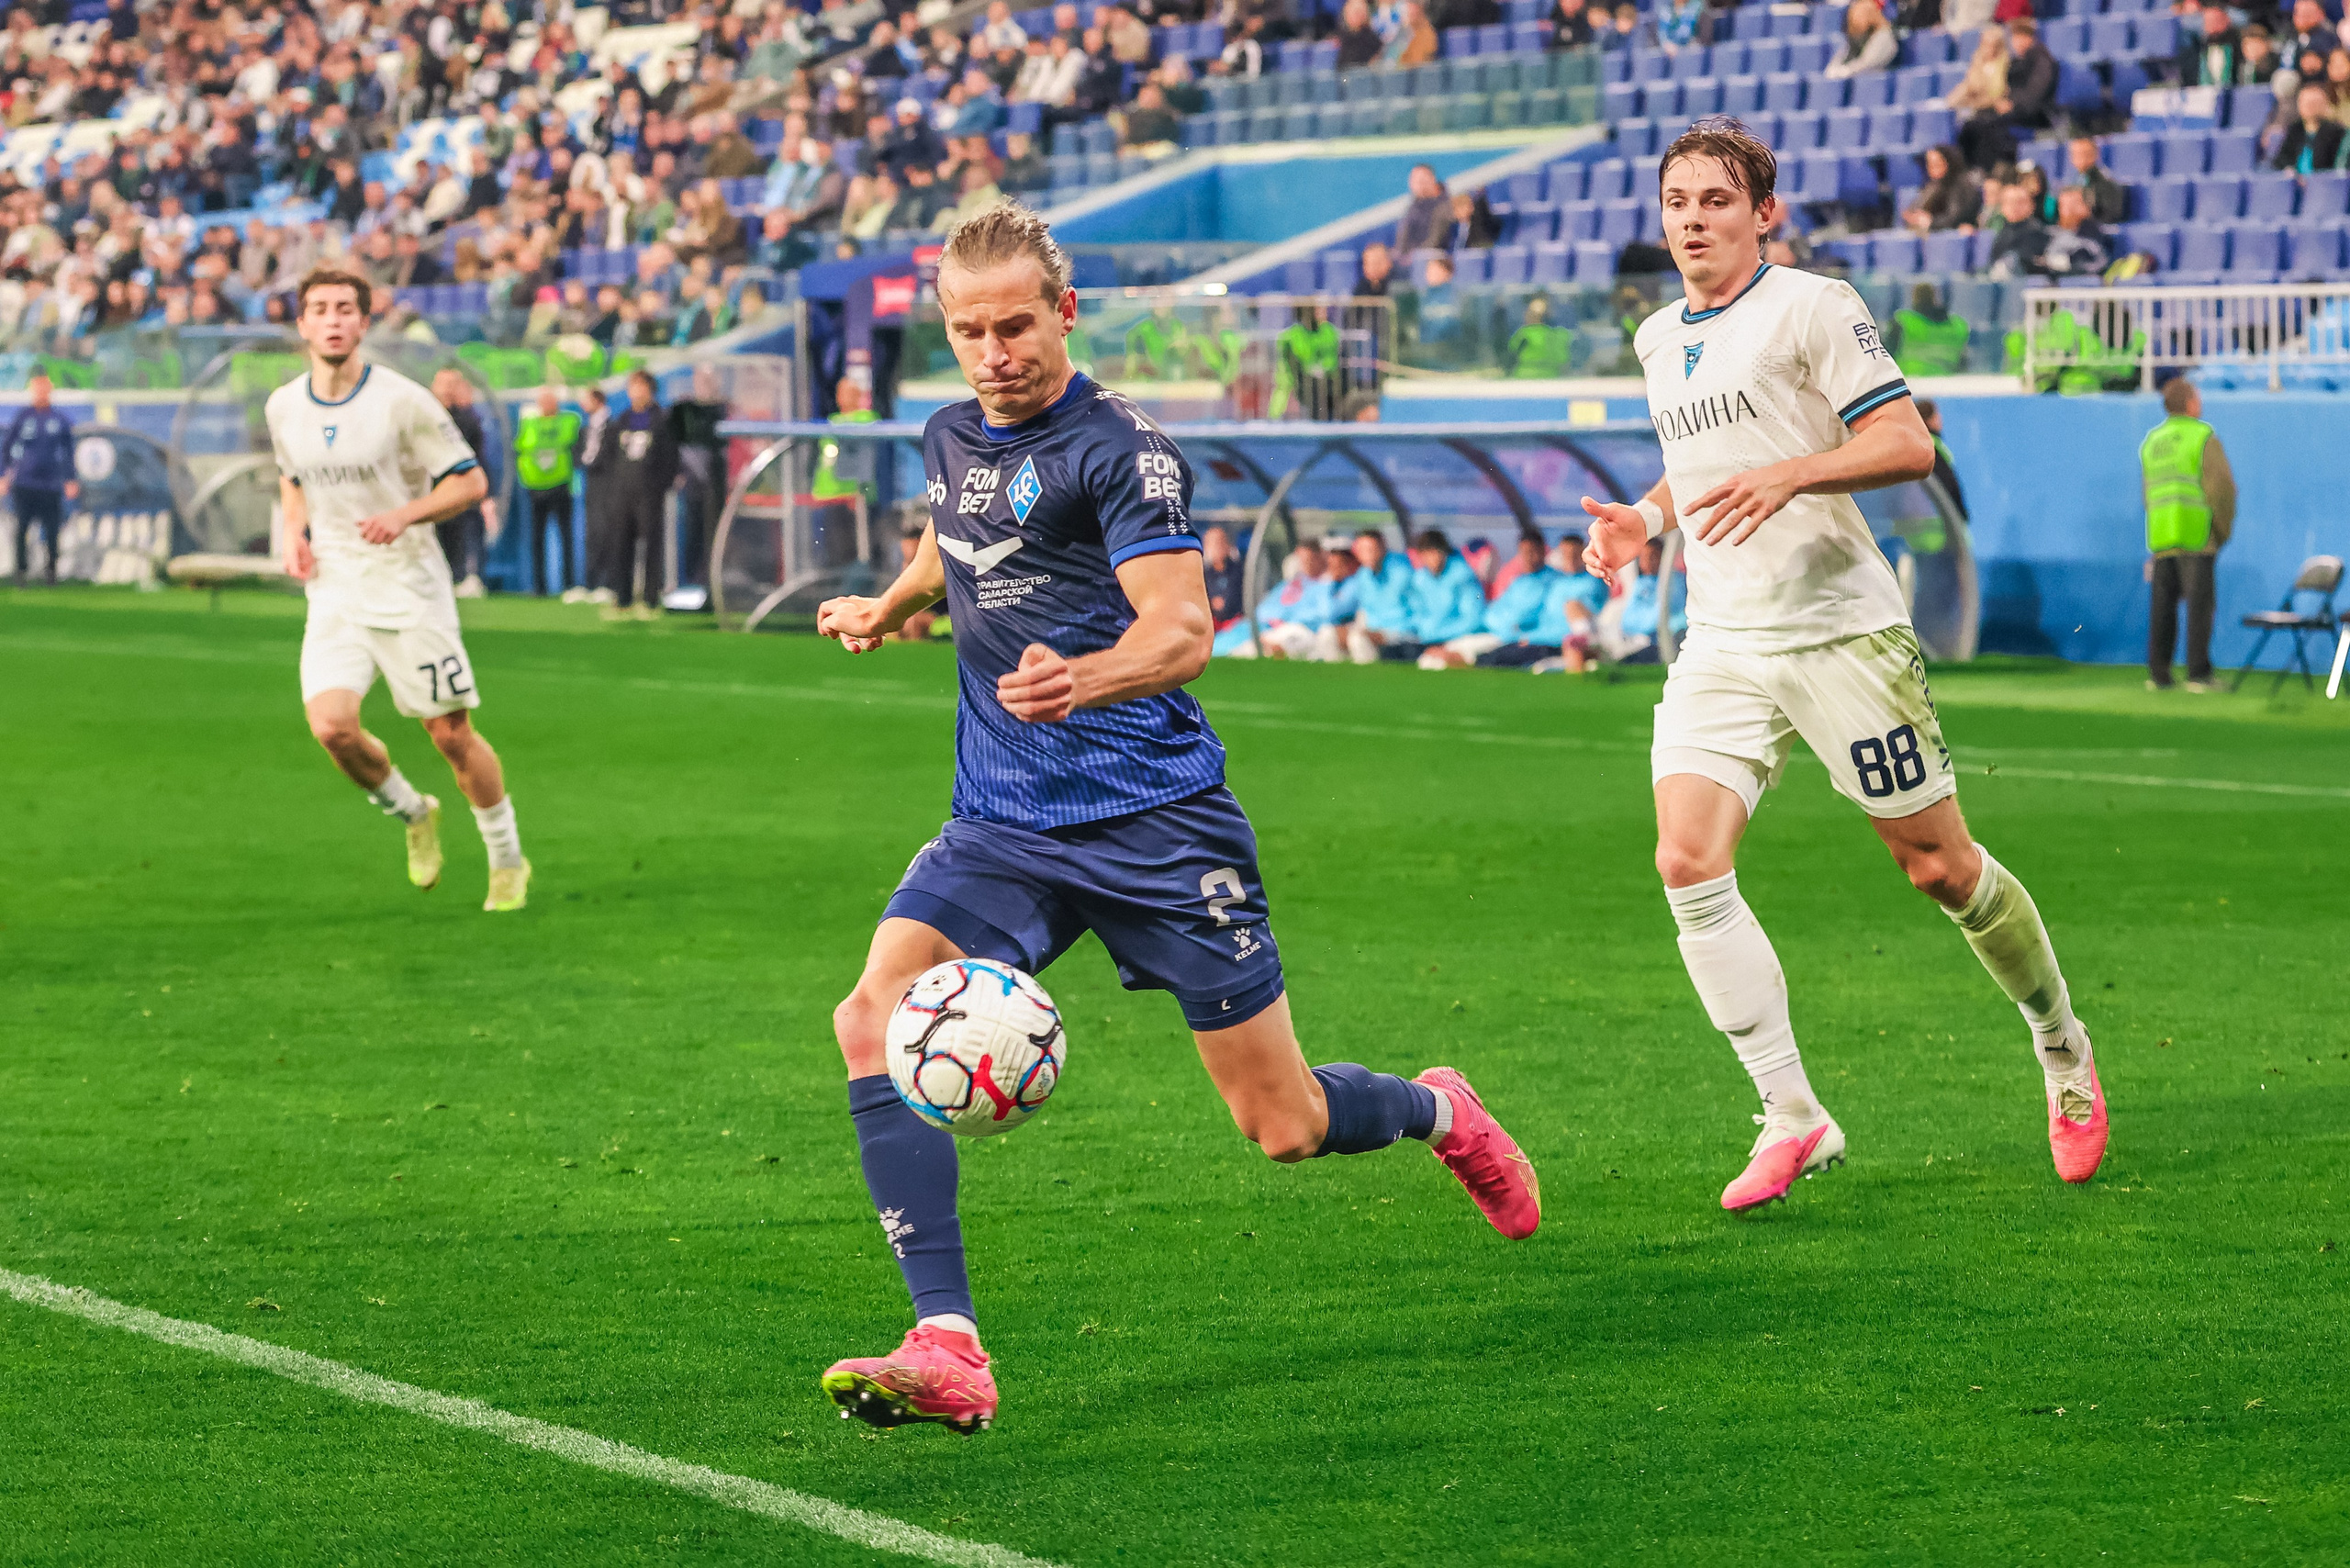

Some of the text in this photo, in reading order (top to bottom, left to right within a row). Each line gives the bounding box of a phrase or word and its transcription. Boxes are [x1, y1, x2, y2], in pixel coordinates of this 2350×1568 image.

[961, 467, 1001, 490] FON
[1138, 454, 1181, 479] FON
[1144, 476, 1181, 501] BET
[957, 491, 995, 514] BET
[976, 597, 1021, 609] ОБЛАСТИ
[419, 655, 472, 701] 72
[1850, 723, 1926, 797] 88
[1200, 867, 1248, 927] 2
